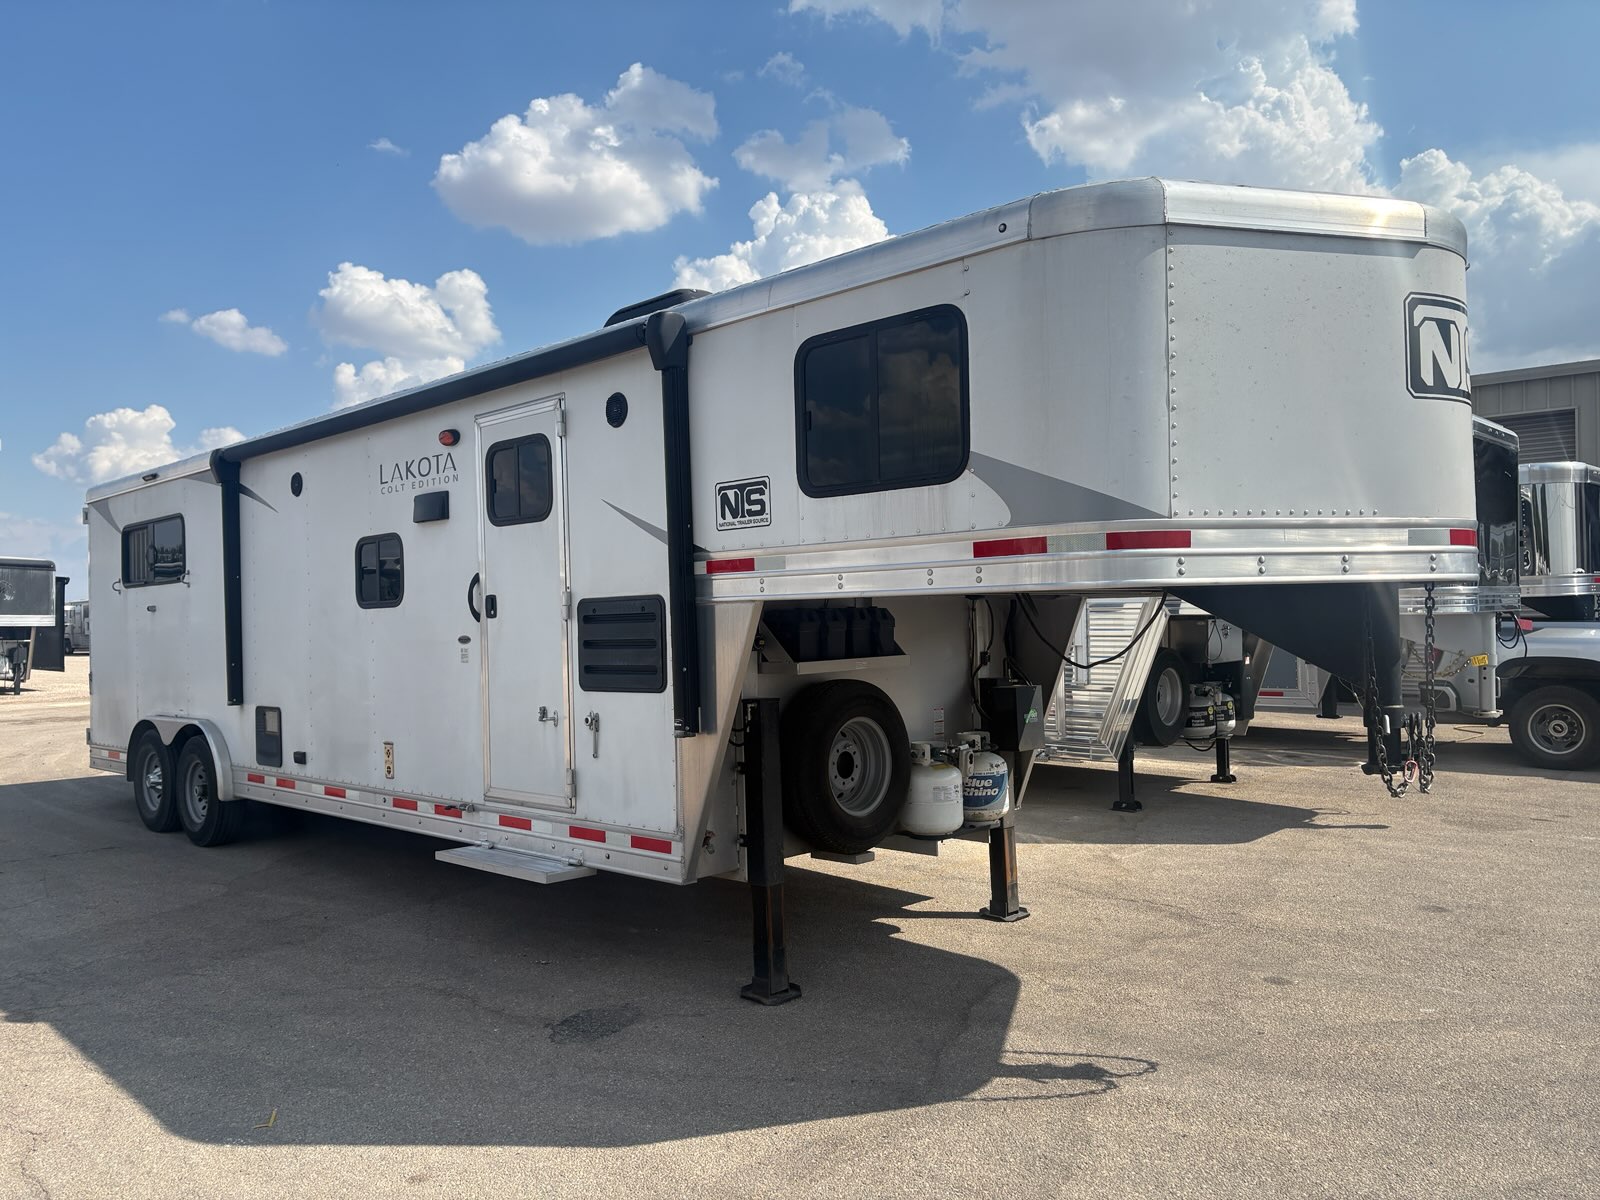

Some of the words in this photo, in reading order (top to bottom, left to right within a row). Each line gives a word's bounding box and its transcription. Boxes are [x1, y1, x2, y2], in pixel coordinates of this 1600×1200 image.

[380, 452, 456, 484] LAKOTA
[381, 483, 405, 494] COLT
[412, 474, 459, 489] EDITION
[718, 480, 767, 520] NTS
